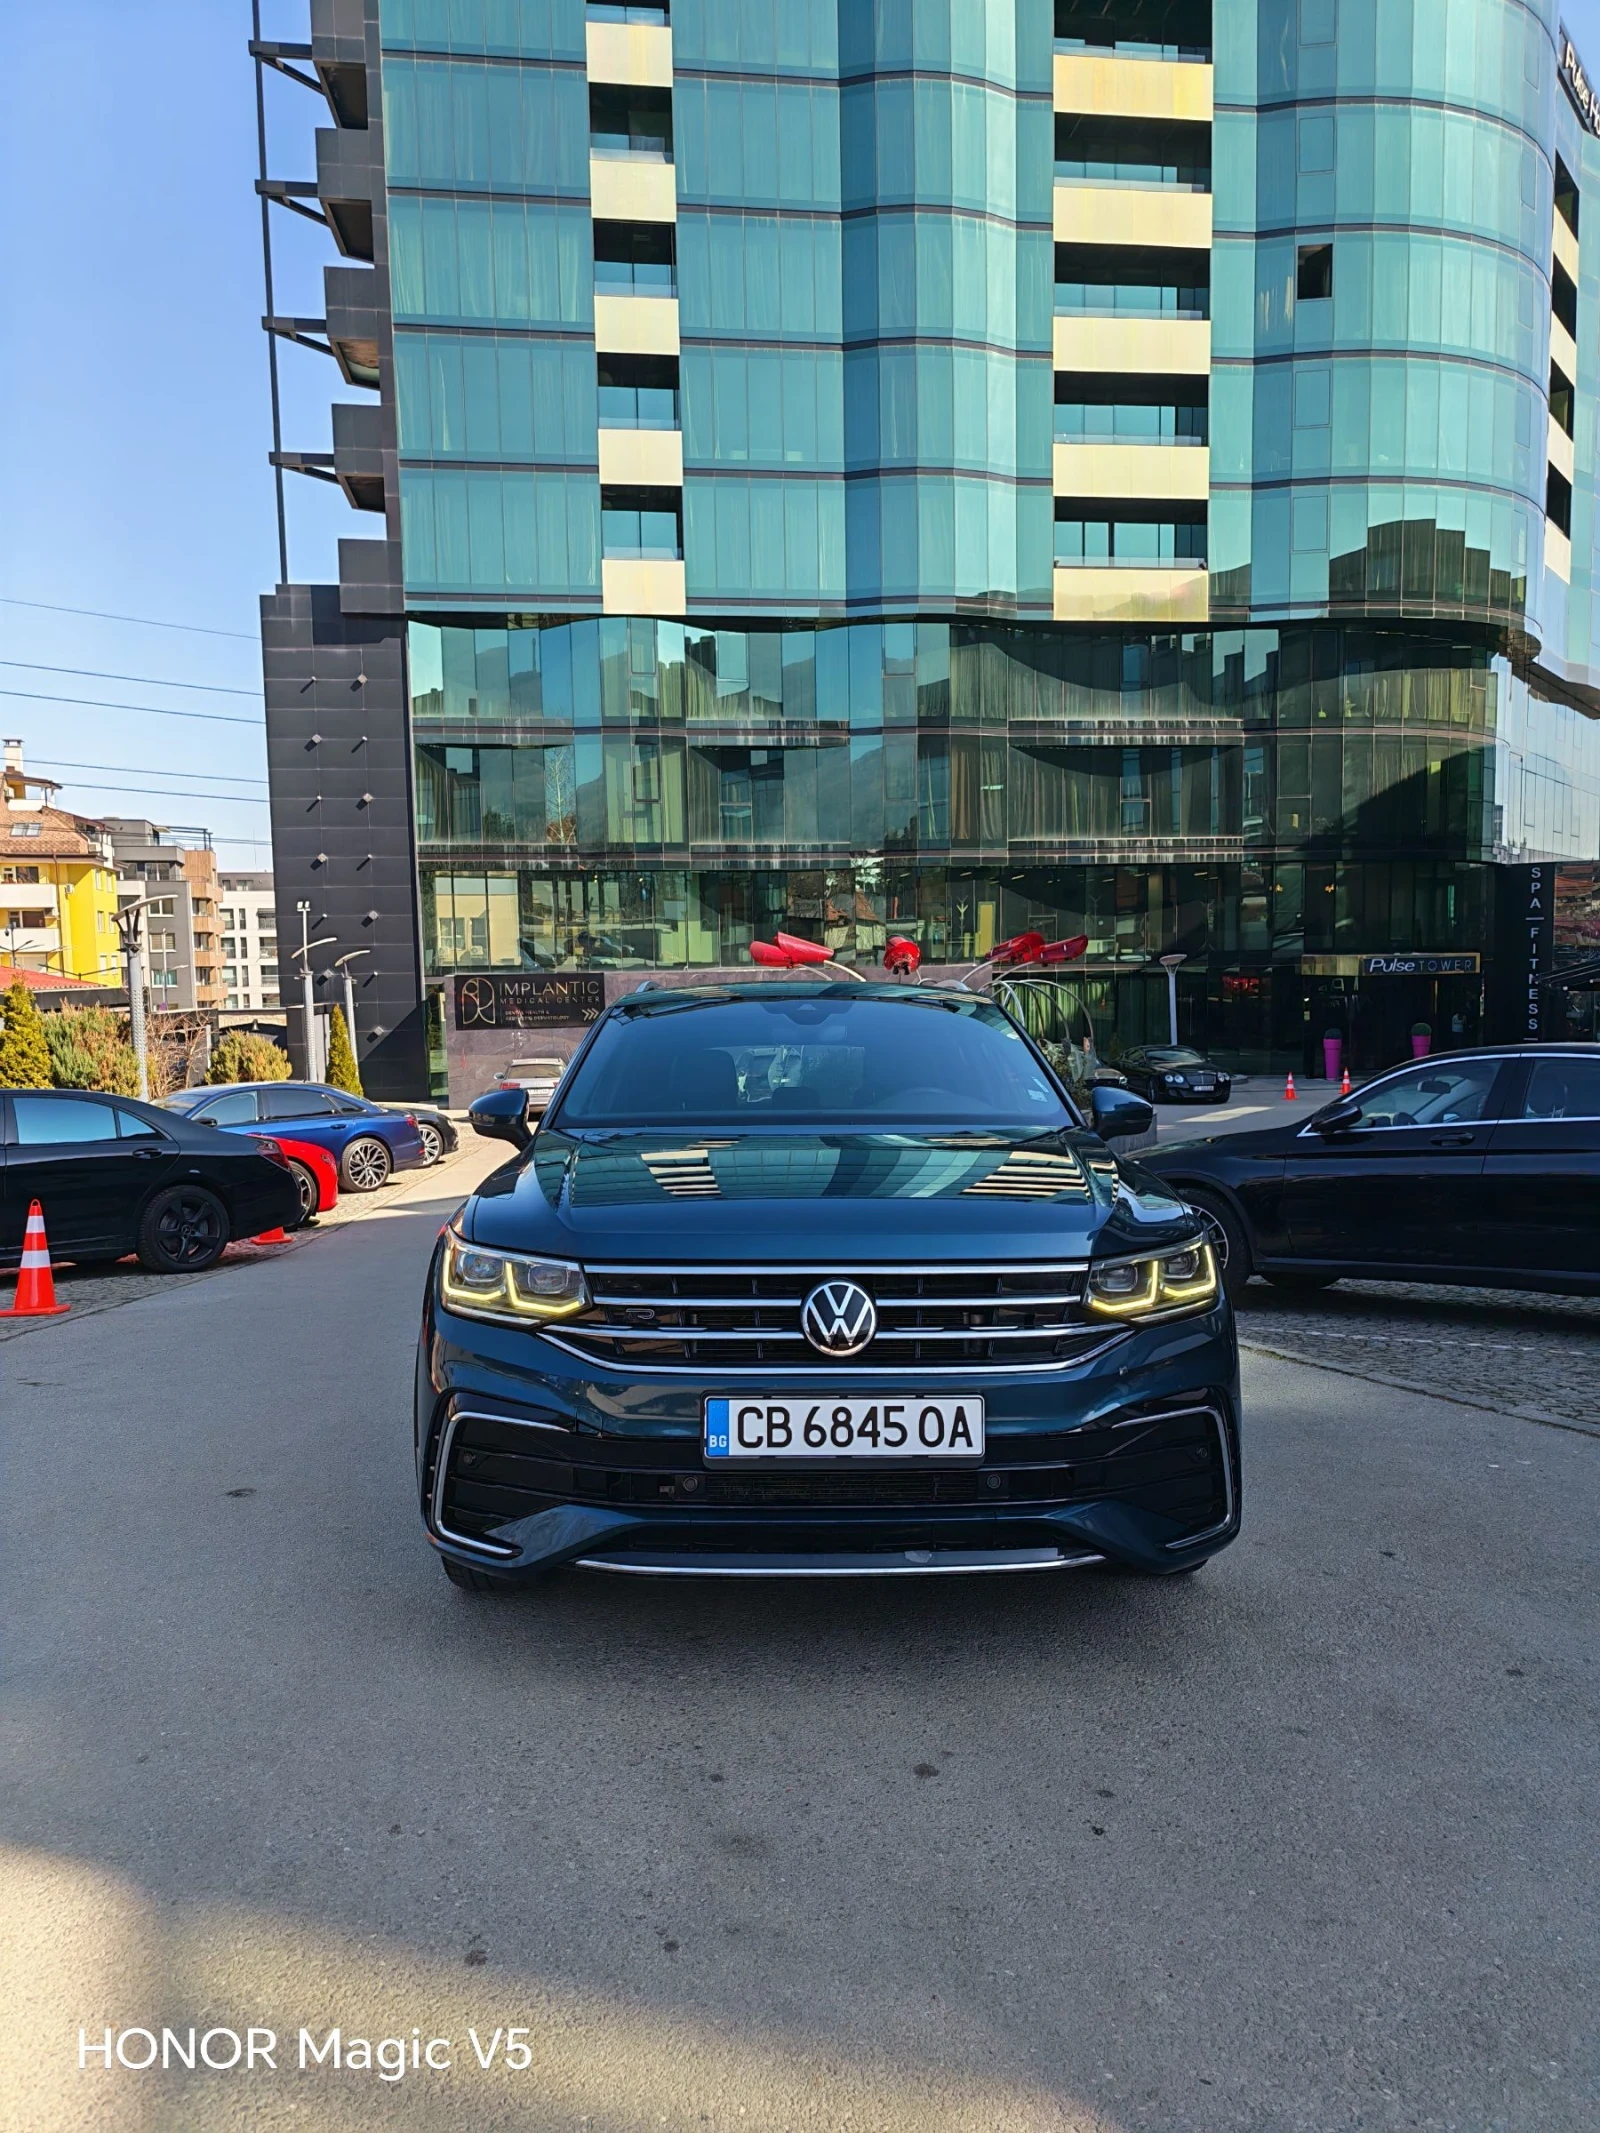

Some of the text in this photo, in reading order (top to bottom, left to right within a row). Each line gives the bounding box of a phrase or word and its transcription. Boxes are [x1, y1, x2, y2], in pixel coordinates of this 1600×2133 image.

[1565, 41, 1589, 110] Pulse
[1528, 867, 1541, 1030] SPA FITNESS
[1369, 958, 1472, 973] Pulse TOWER
[500, 981, 600, 996] IMPLANTIC
[500, 996, 600, 1005] MEDICAL CENTER
[737, 1406, 793, 1449] CB
[803, 1406, 908, 1448] 6845
[709, 1435, 727, 1447] BG
